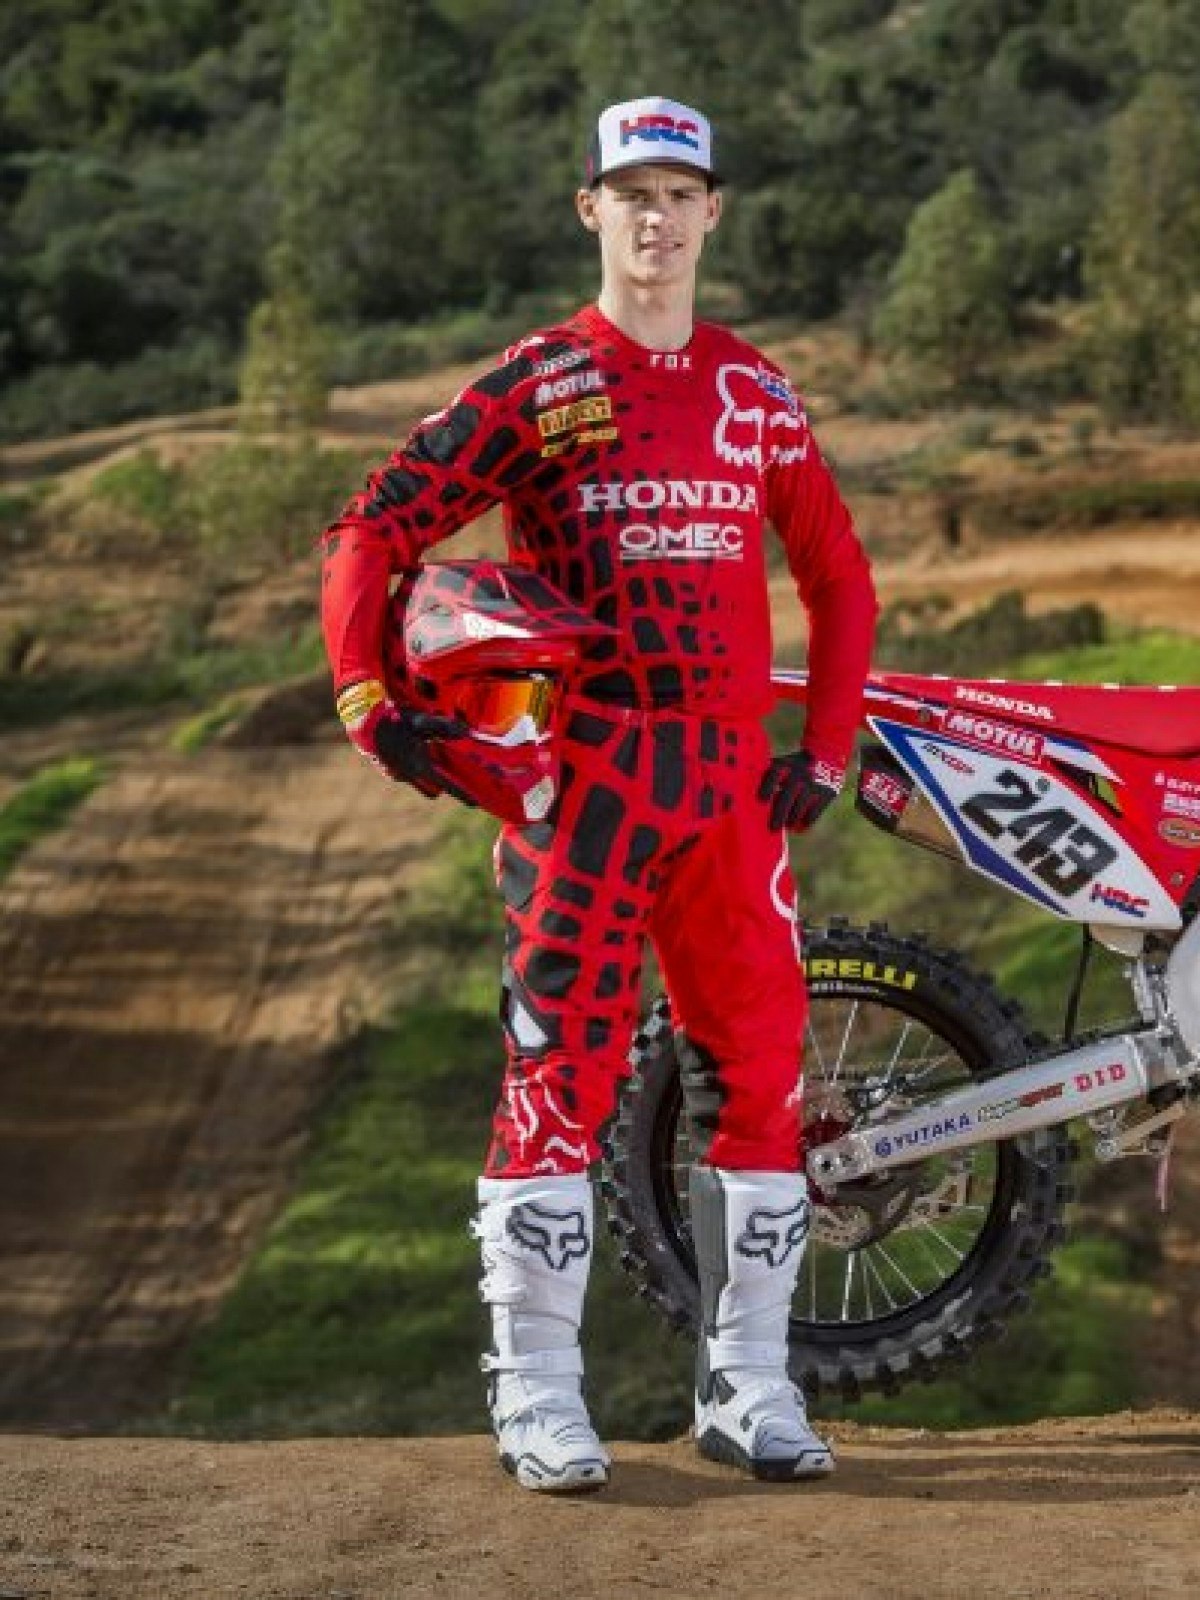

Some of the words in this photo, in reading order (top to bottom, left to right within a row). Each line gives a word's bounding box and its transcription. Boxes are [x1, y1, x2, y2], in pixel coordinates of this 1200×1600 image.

[620, 114, 699, 150] HRC
[650, 354, 692, 370] FOX
[577, 480, 760, 513] HONDA
[618, 523, 744, 550] OMEC
[956, 685, 1055, 720] HONDA
[948, 714, 1038, 757] MOTUL
[959, 769, 1119, 898] 243
[1090, 883, 1150, 918] HRC
[893, 1112, 971, 1150] YUTAKA
